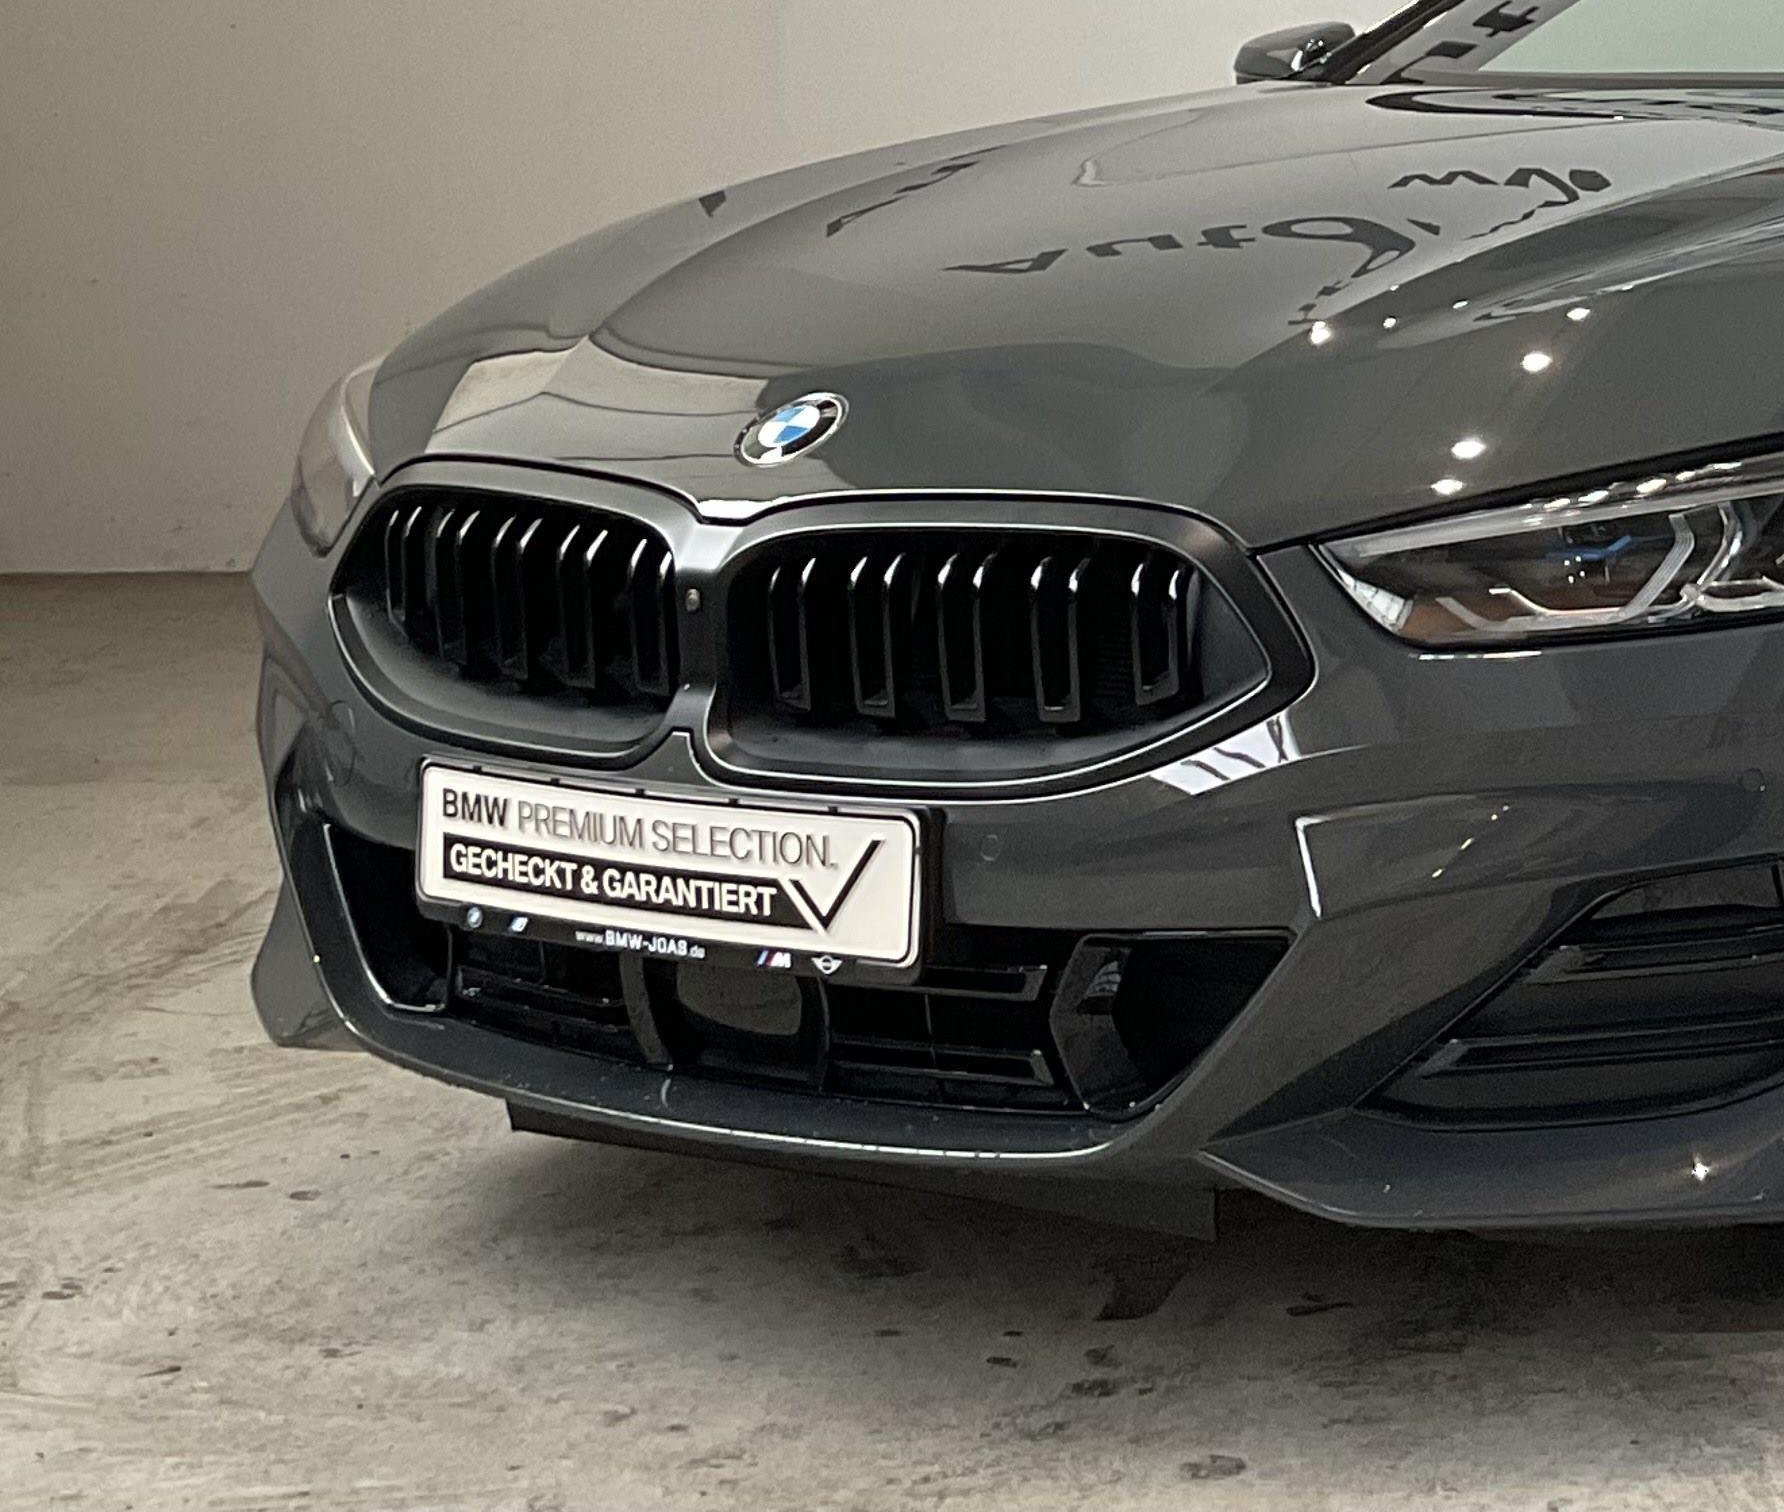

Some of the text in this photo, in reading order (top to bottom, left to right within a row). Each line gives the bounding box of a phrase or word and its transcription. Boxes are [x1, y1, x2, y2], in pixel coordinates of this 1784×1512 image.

[443, 788, 839, 870] BMW PREMIUM SELECTION.
[450, 843, 778, 917] GECHECKT & GARANTIERT
